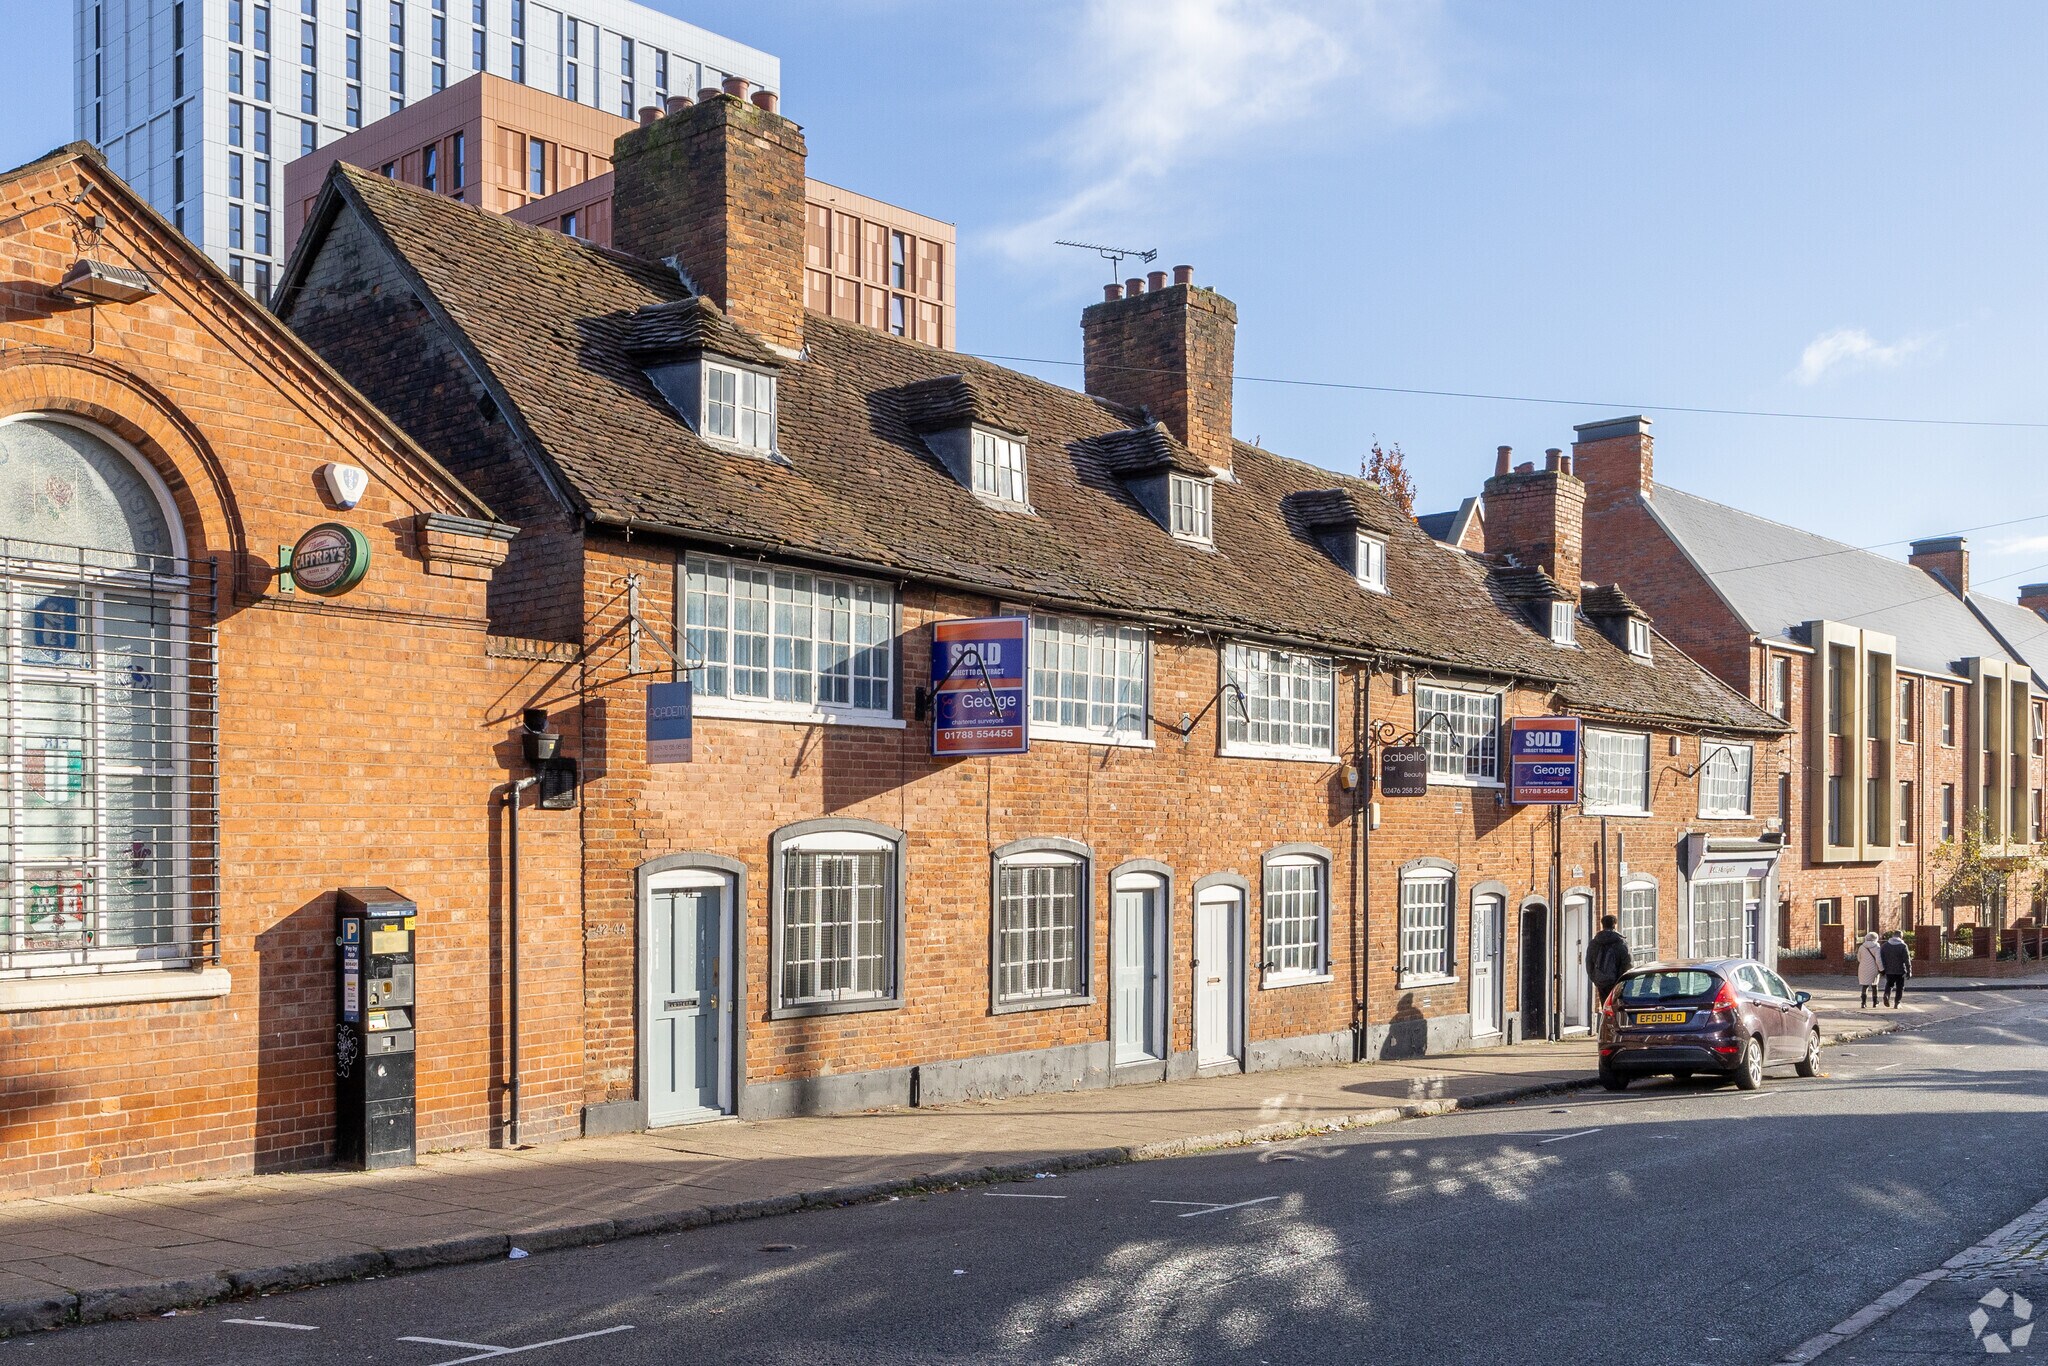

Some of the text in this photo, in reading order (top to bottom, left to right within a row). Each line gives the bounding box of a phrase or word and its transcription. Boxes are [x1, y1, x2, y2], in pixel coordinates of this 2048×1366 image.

[296, 547, 346, 570] CAFFREY'S
[951, 642, 1001, 667] SOLD
[649, 705, 690, 719] ACADEMY
[952, 717, 1004, 726] chartered surveyors
[944, 729, 1013, 740] 01788 554455
[1525, 731, 1561, 747] SOLD
[1383, 751, 1426, 762] cabello
[1533, 765, 1571, 776] George
[347, 923, 357, 940] P
[345, 945, 353, 953] Pay
[1640, 1013, 1682, 1023] EF09 HLO
